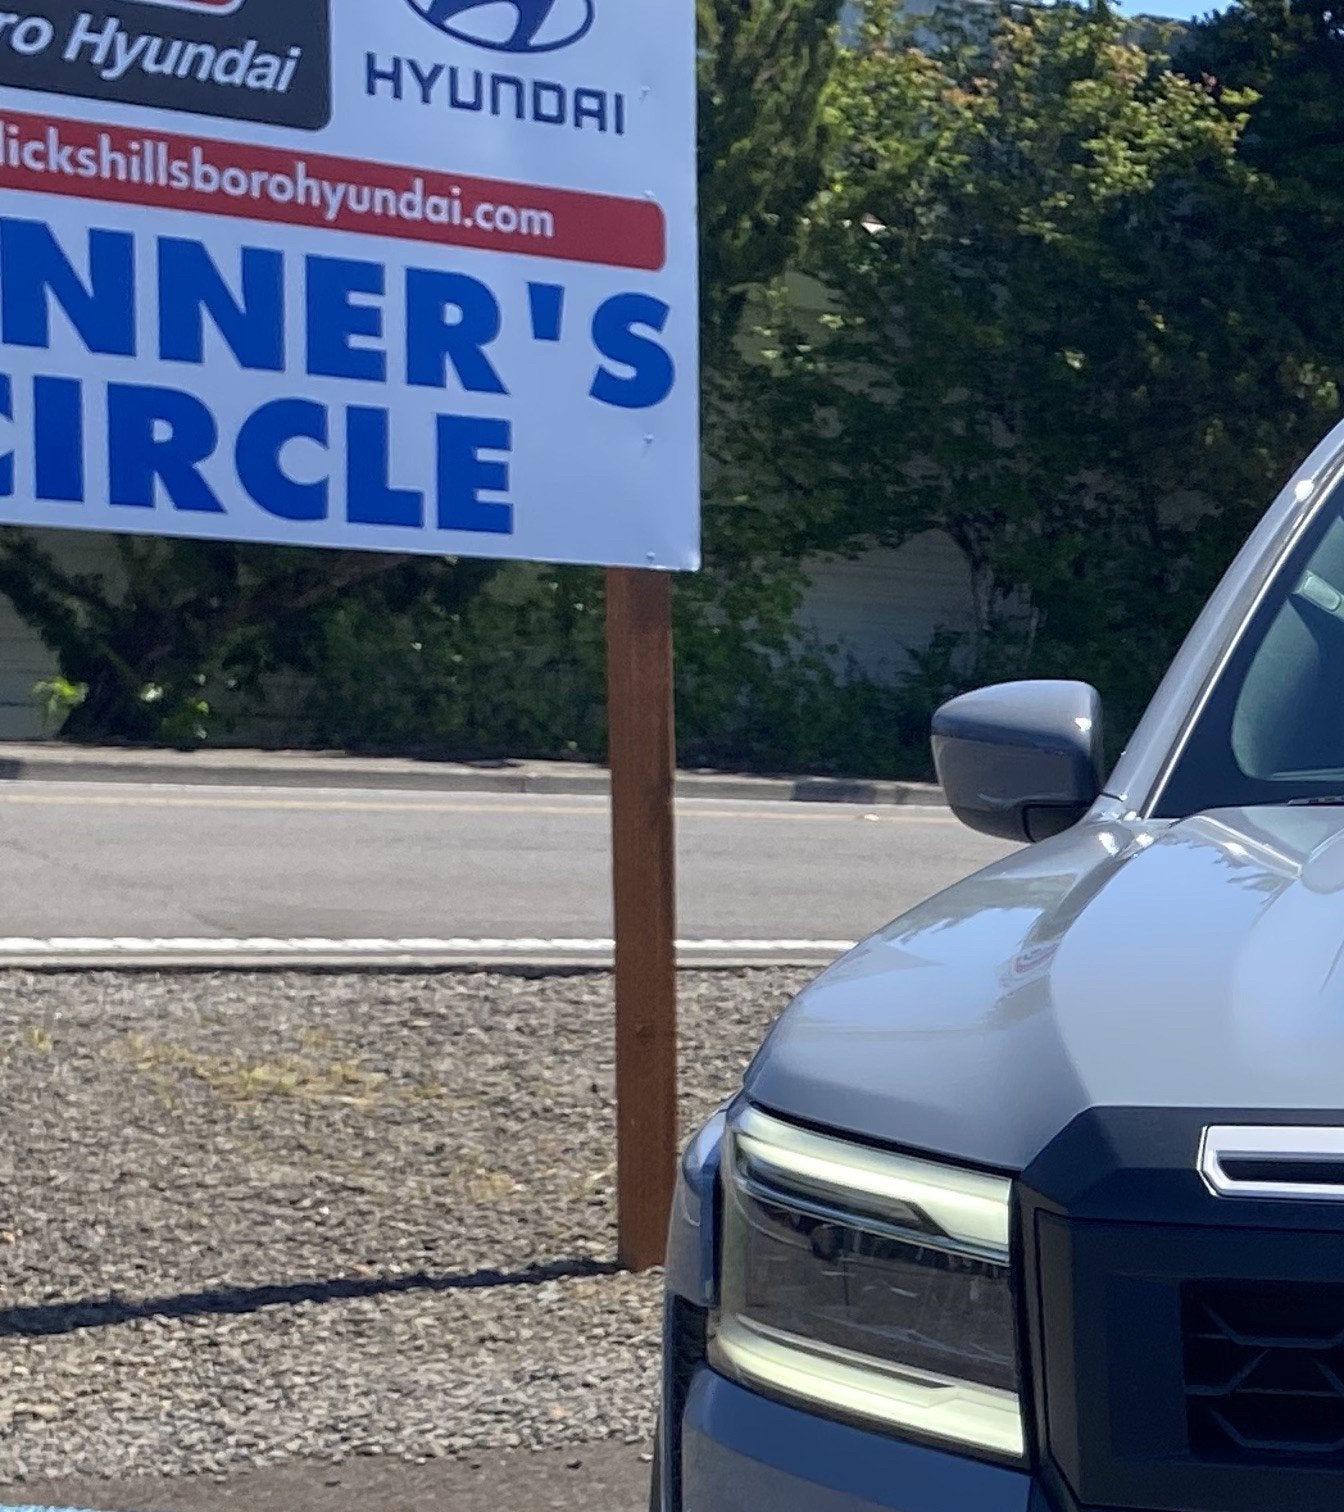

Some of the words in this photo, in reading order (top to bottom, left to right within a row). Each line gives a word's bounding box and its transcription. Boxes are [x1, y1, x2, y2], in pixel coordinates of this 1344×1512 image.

[62, 12, 301, 93] Hyundai
[365, 51, 624, 135] HYUNDAI
[0, 120, 555, 239] ickshillsborohyundai.com
[0, 372, 514, 535] IRCLE
